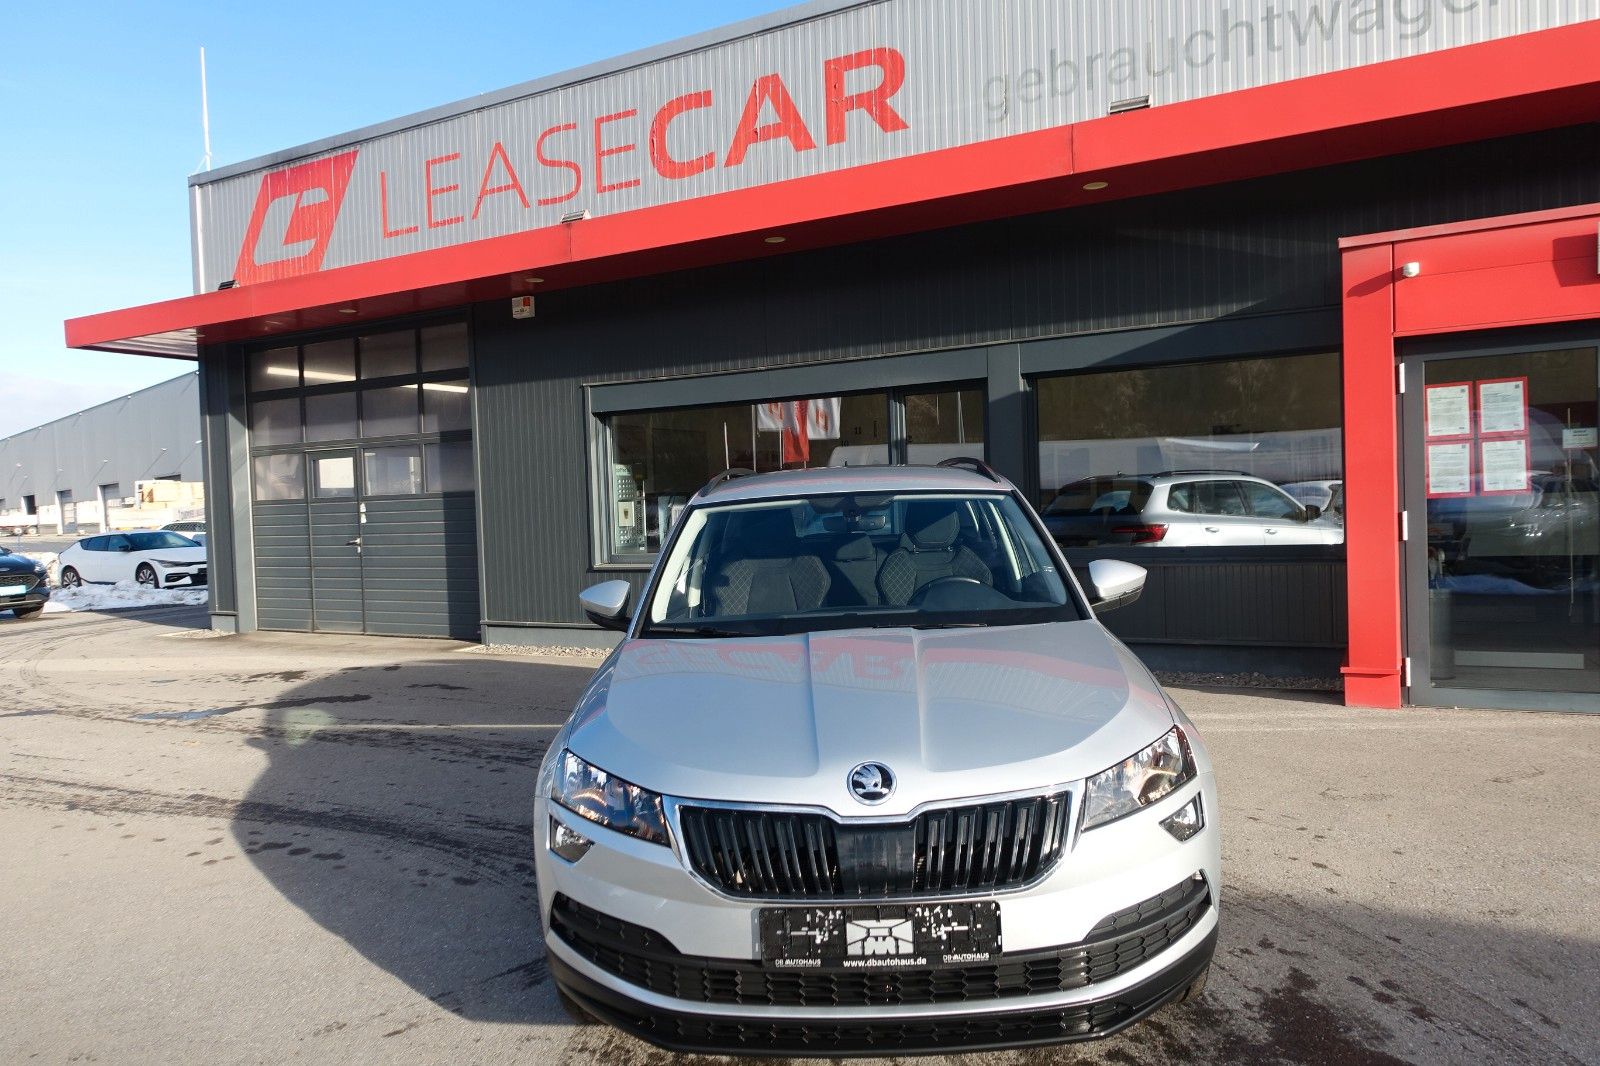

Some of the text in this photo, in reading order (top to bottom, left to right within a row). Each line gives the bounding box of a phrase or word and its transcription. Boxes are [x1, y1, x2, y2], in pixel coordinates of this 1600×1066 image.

[982, 0, 1498, 124] gebrauchtwag
[380, 46, 909, 239] LEASECAR
[785, 958, 822, 966] AUTOHAUS
[843, 956, 927, 968] www.dbautohaus.de
[952, 952, 990, 961] AUTOHAUS
